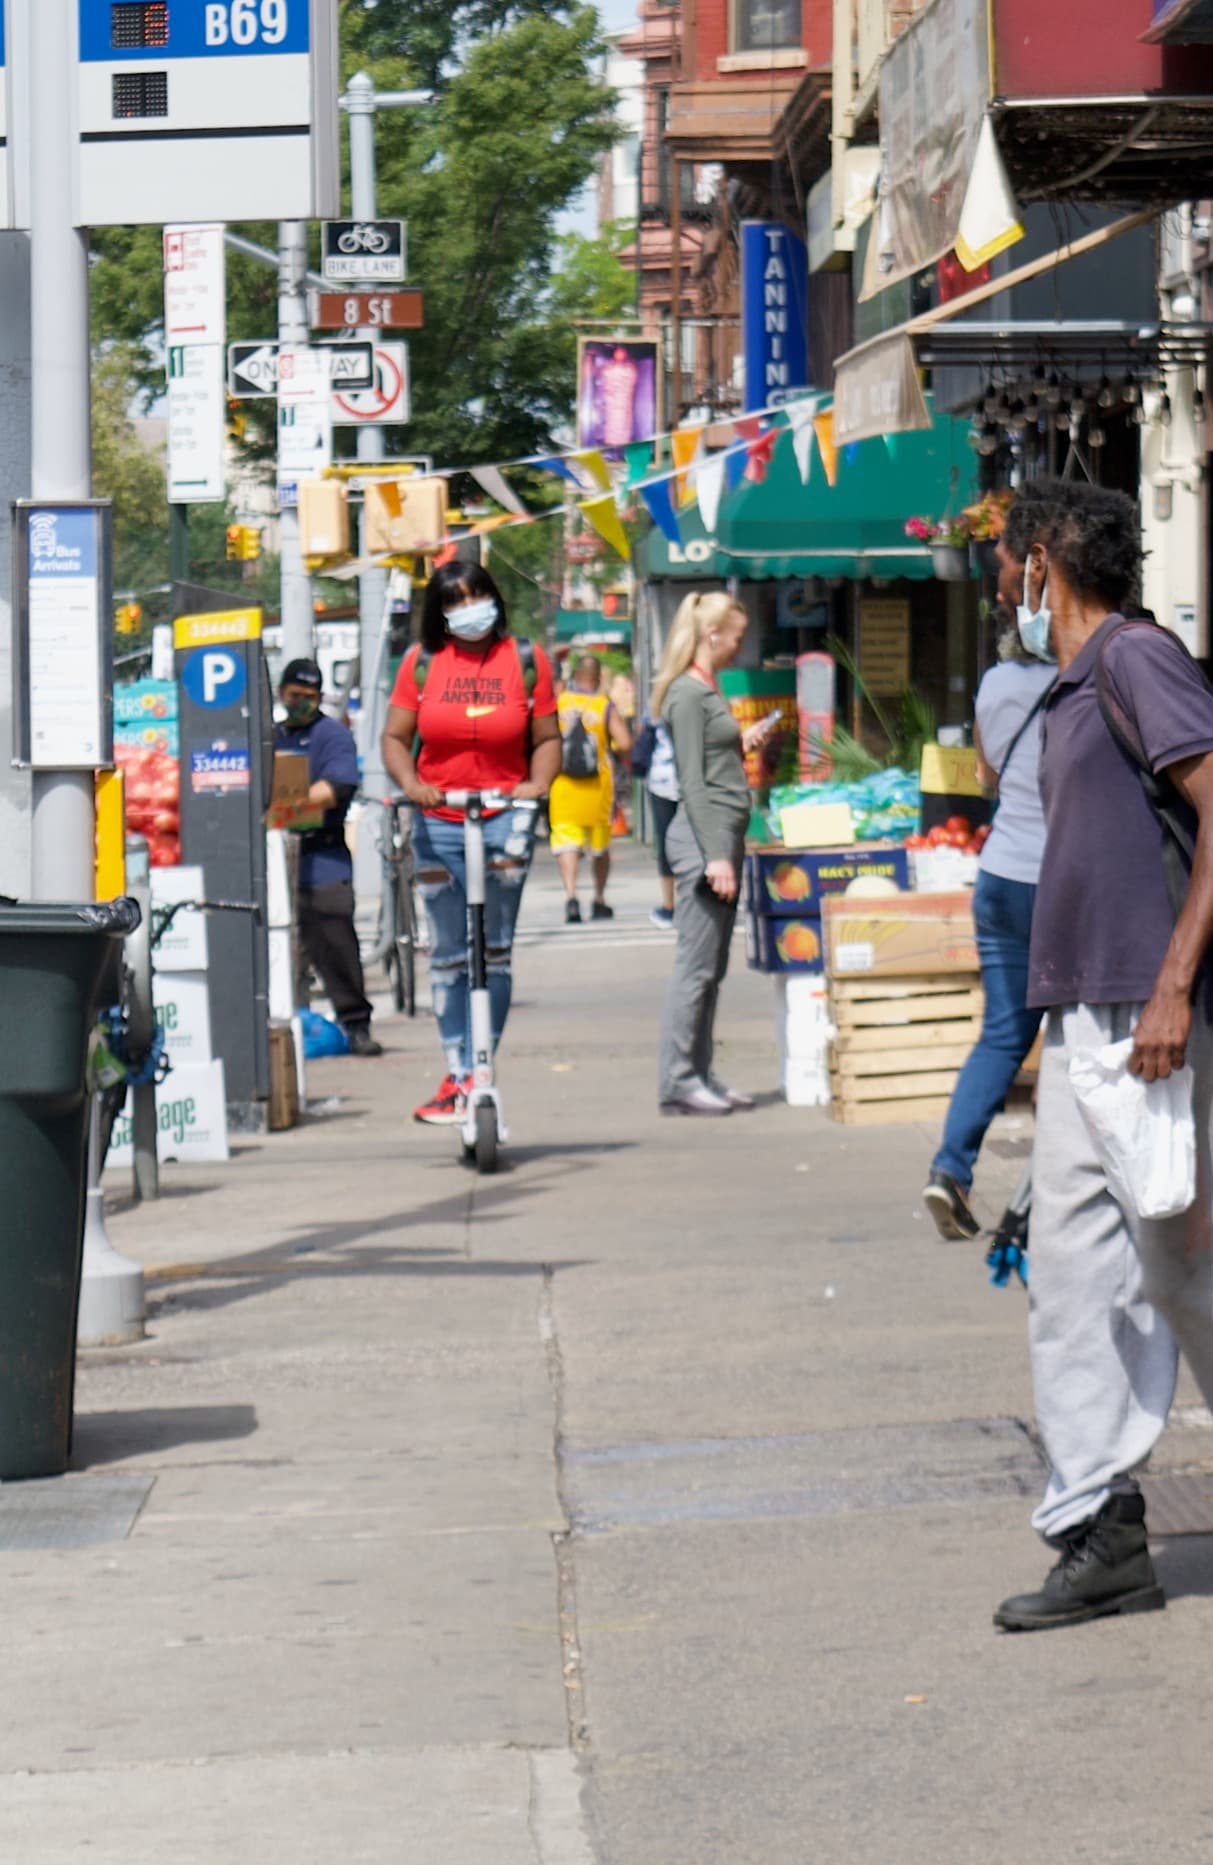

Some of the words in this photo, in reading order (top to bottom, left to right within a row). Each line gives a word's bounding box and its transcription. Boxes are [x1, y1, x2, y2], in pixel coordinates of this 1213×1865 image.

[205, 0, 288, 46] B69
[327, 260, 357, 274] BIKE
[363, 259, 398, 273] LANE
[344, 298, 359, 325] 8
[764, 230, 788, 409] TANNING
[56, 545, 81, 558] Bus
[33, 560, 80, 573] Arrivals
[203, 653, 235, 703] P
[453, 678, 477, 689] AM
[479, 679, 503, 689] THE
[441, 691, 505, 705] ANSWER
